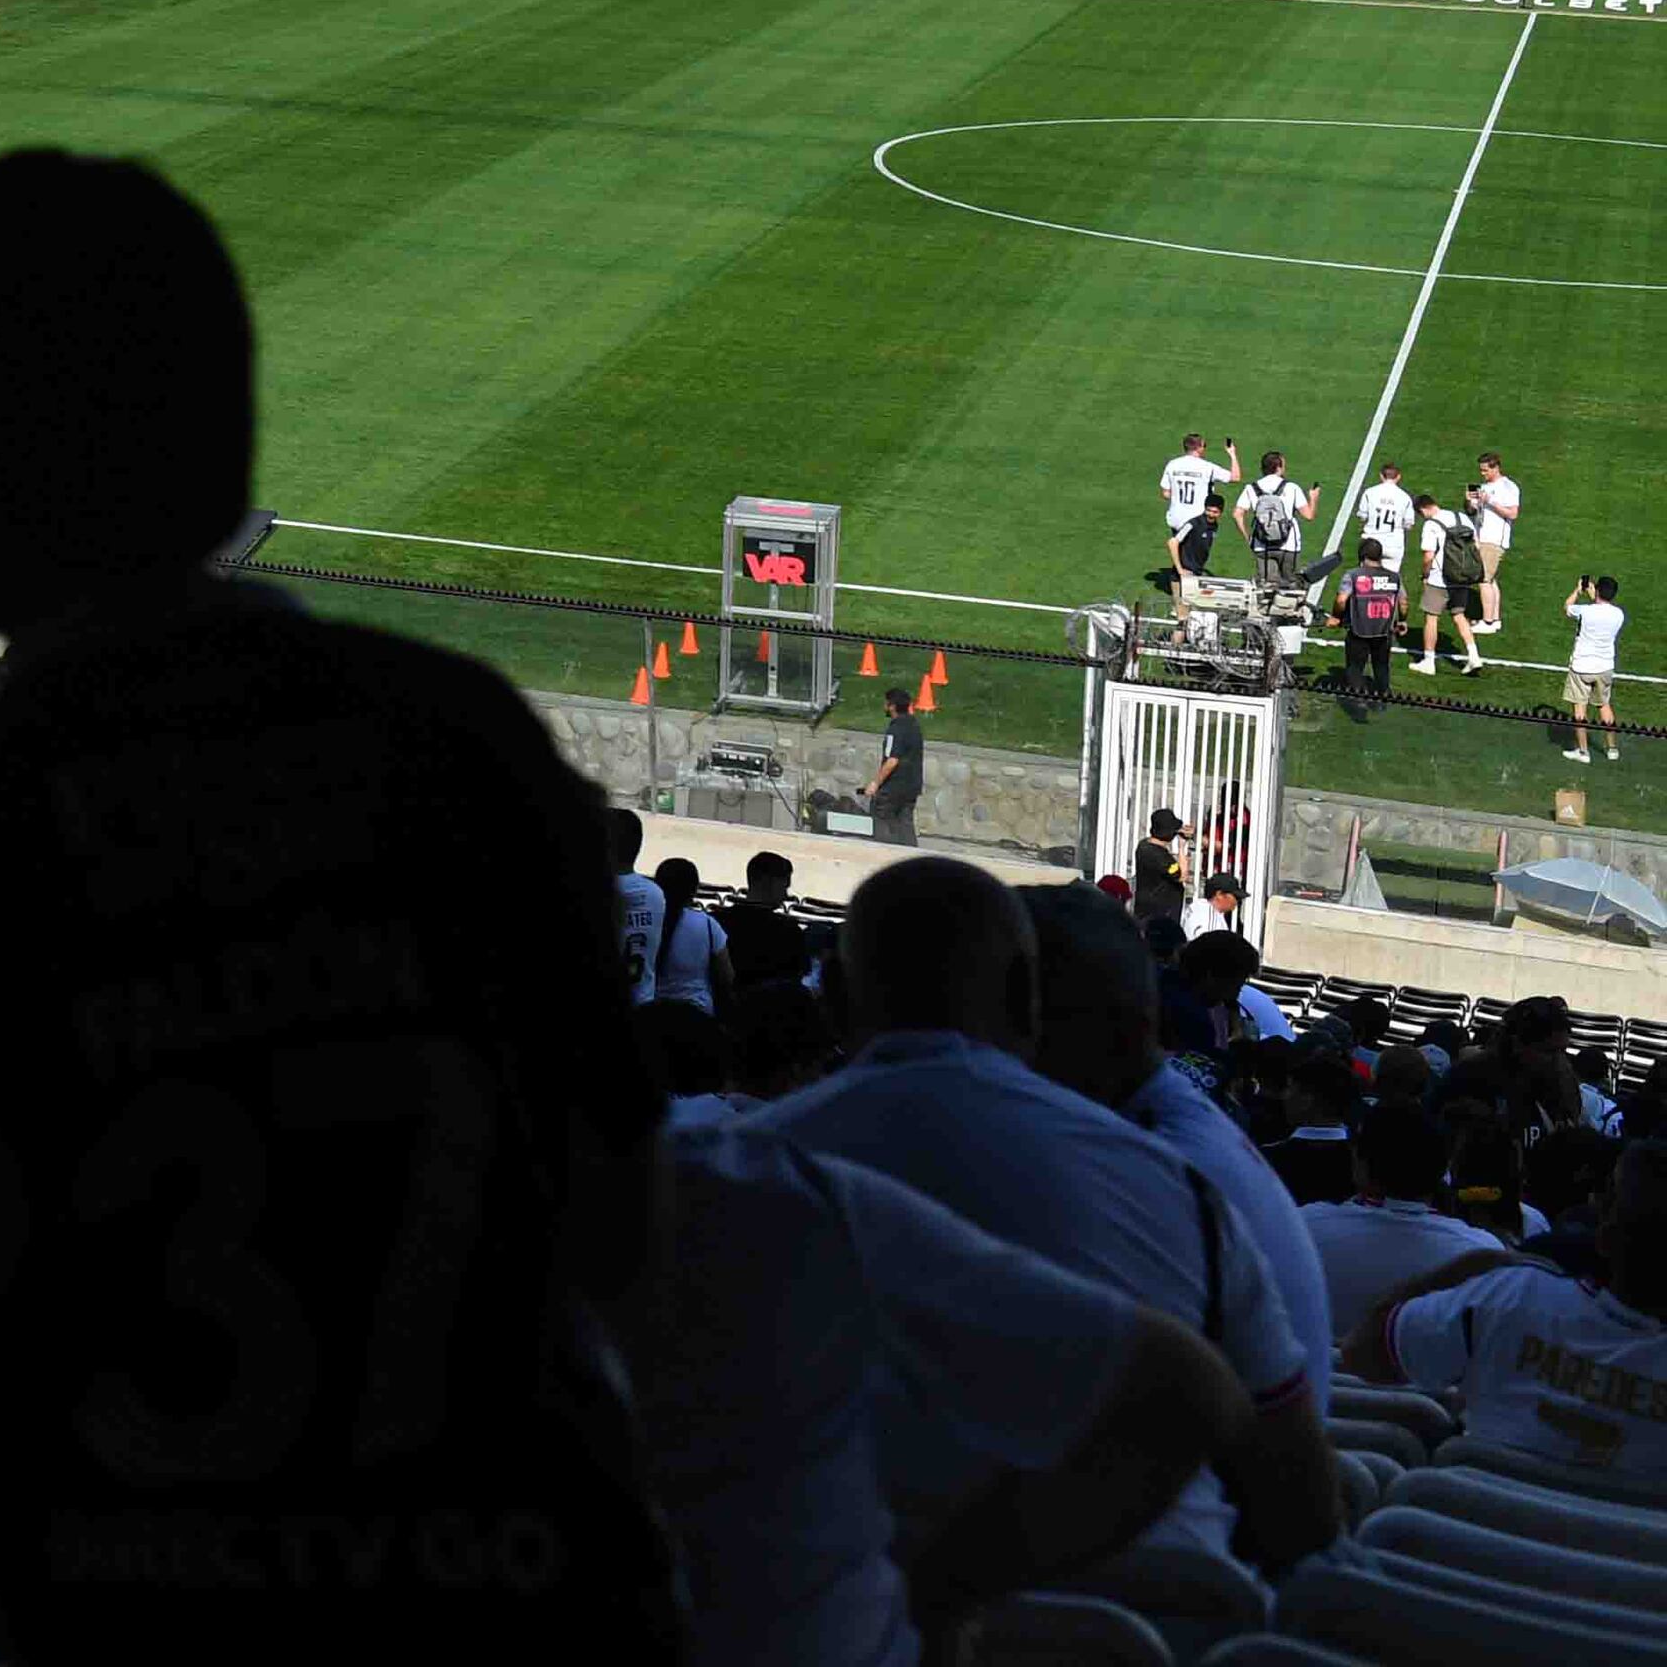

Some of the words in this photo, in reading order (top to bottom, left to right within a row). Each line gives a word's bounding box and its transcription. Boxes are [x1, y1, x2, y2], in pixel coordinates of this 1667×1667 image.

[1178, 480, 1195, 505] 10
[1375, 508, 1396, 533] 14
[745, 553, 805, 586] VAR
